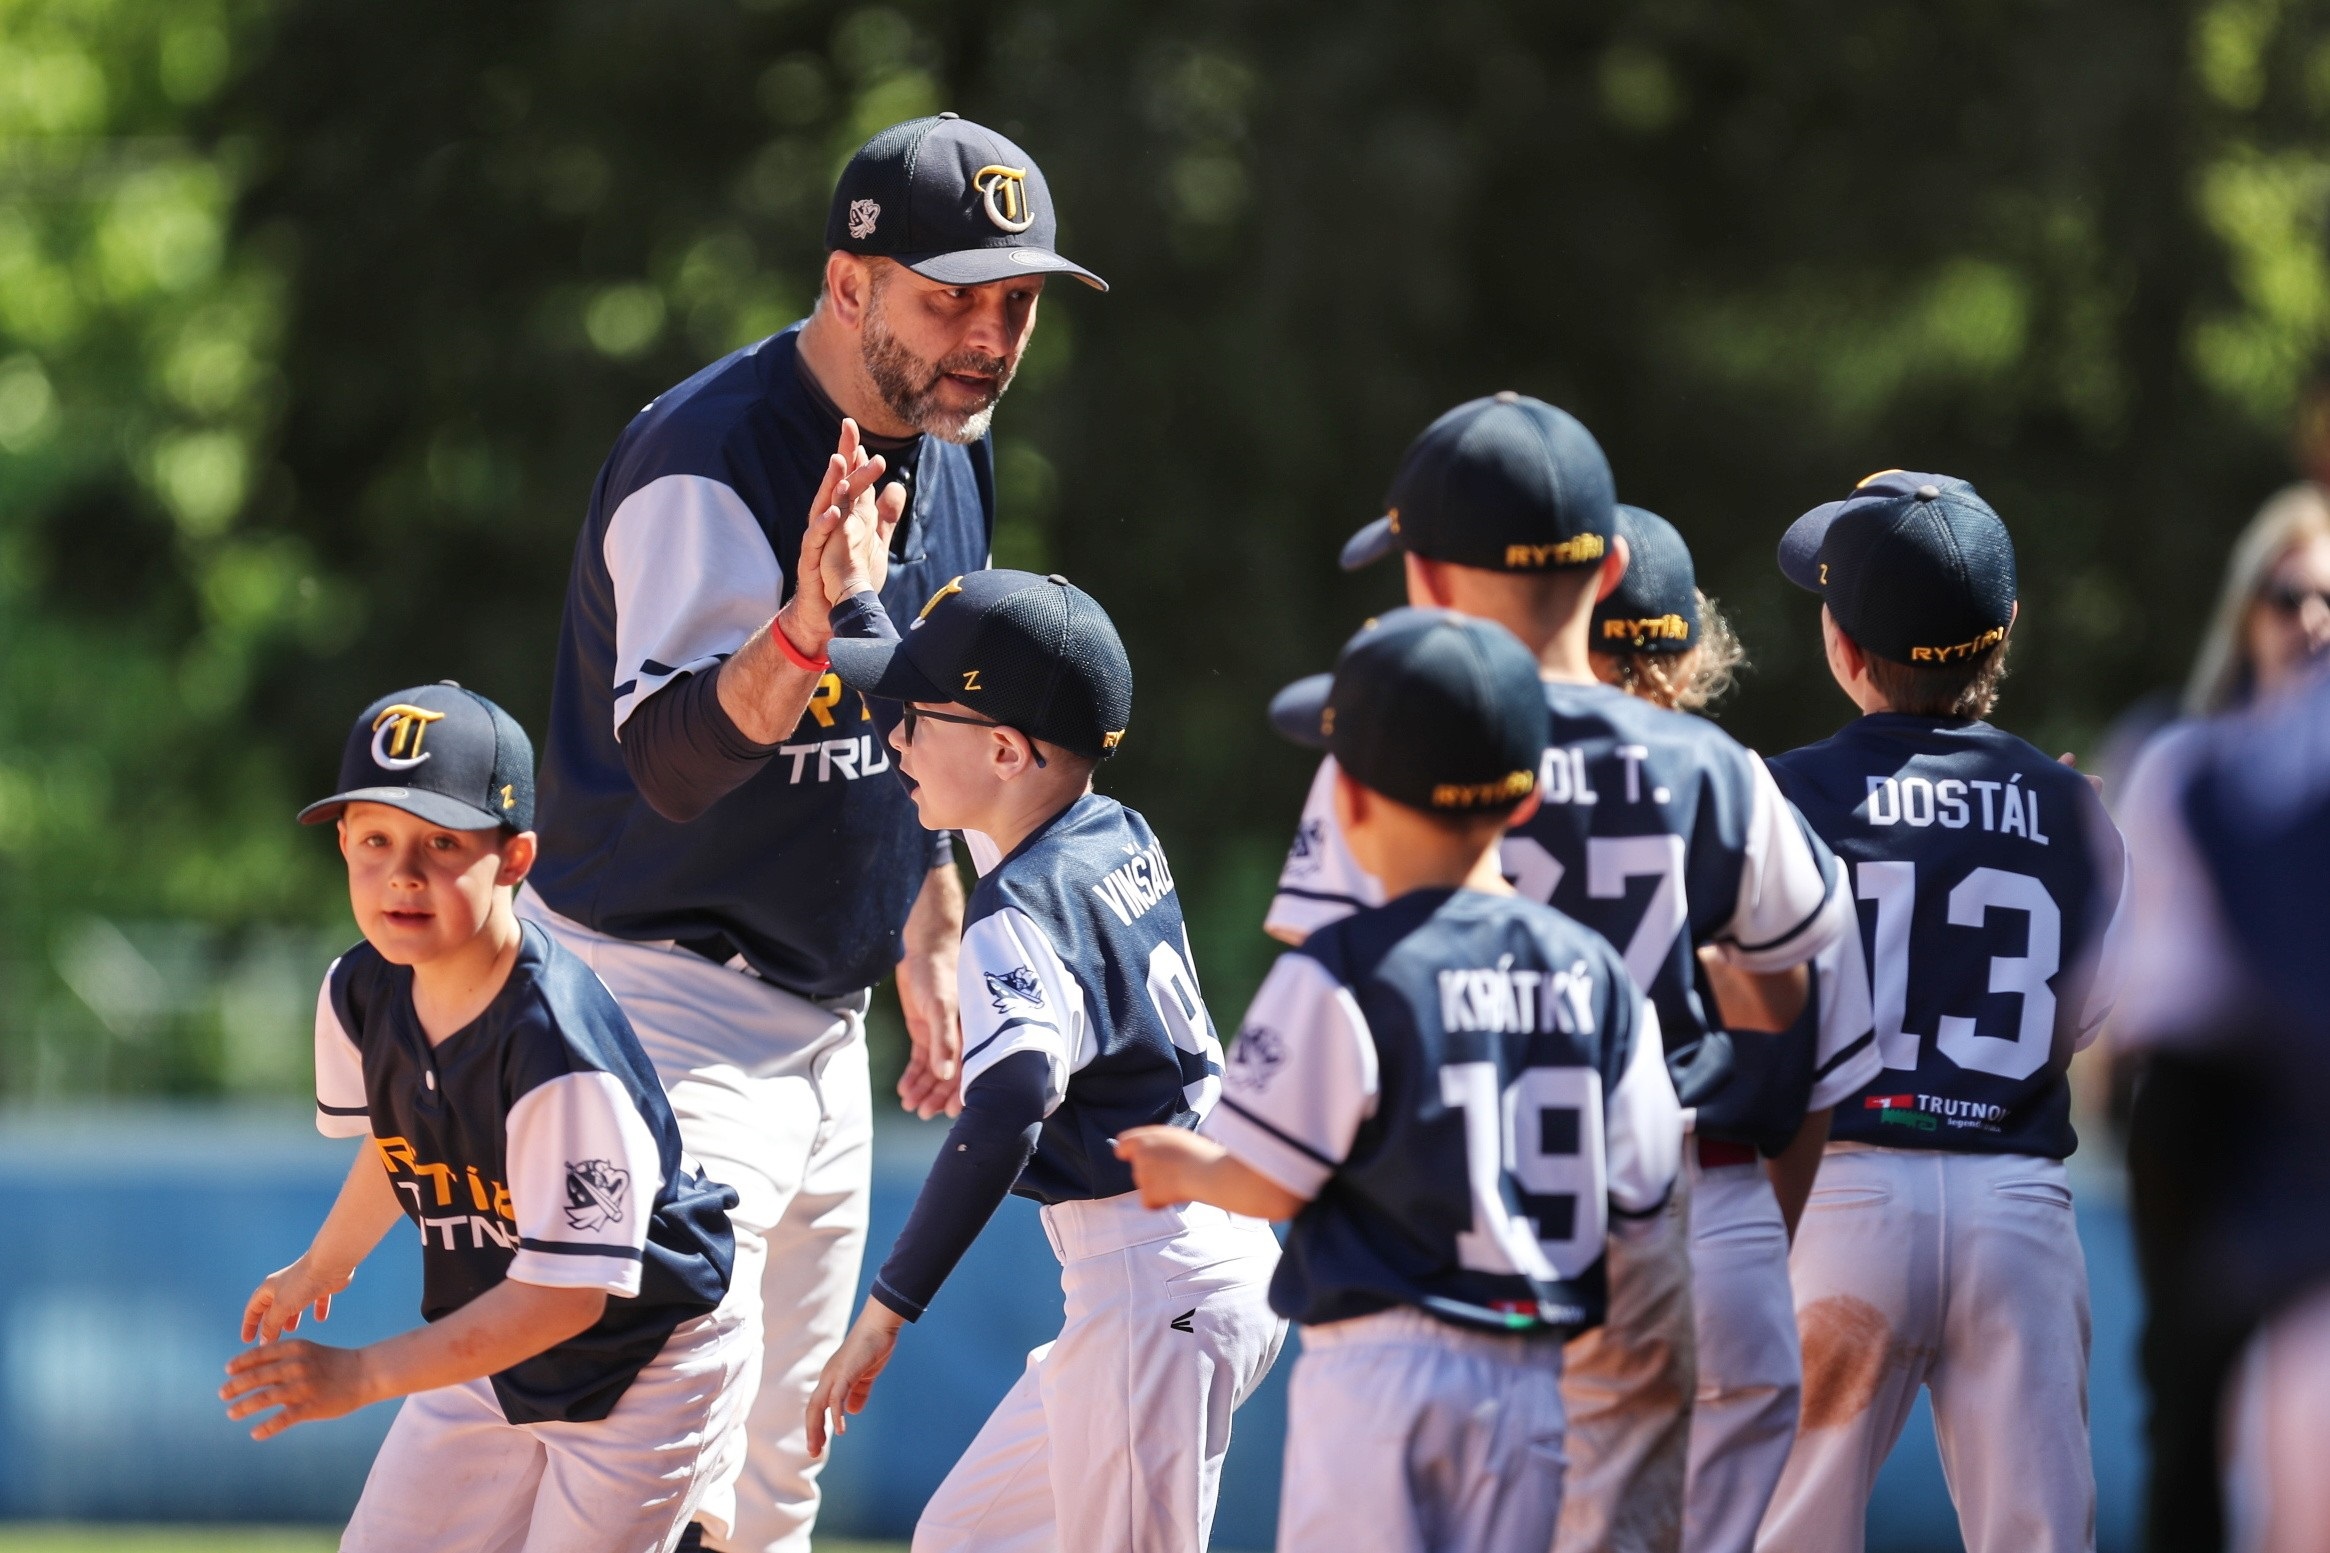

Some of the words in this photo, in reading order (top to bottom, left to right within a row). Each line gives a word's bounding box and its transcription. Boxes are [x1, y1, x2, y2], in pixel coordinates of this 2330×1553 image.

[1866, 773, 2050, 847] DOSTÁL
[1438, 952, 1596, 1034] KRÁTKÝ
[1856, 860, 2062, 1082] 13
[1439, 1061, 1607, 1281] 19
